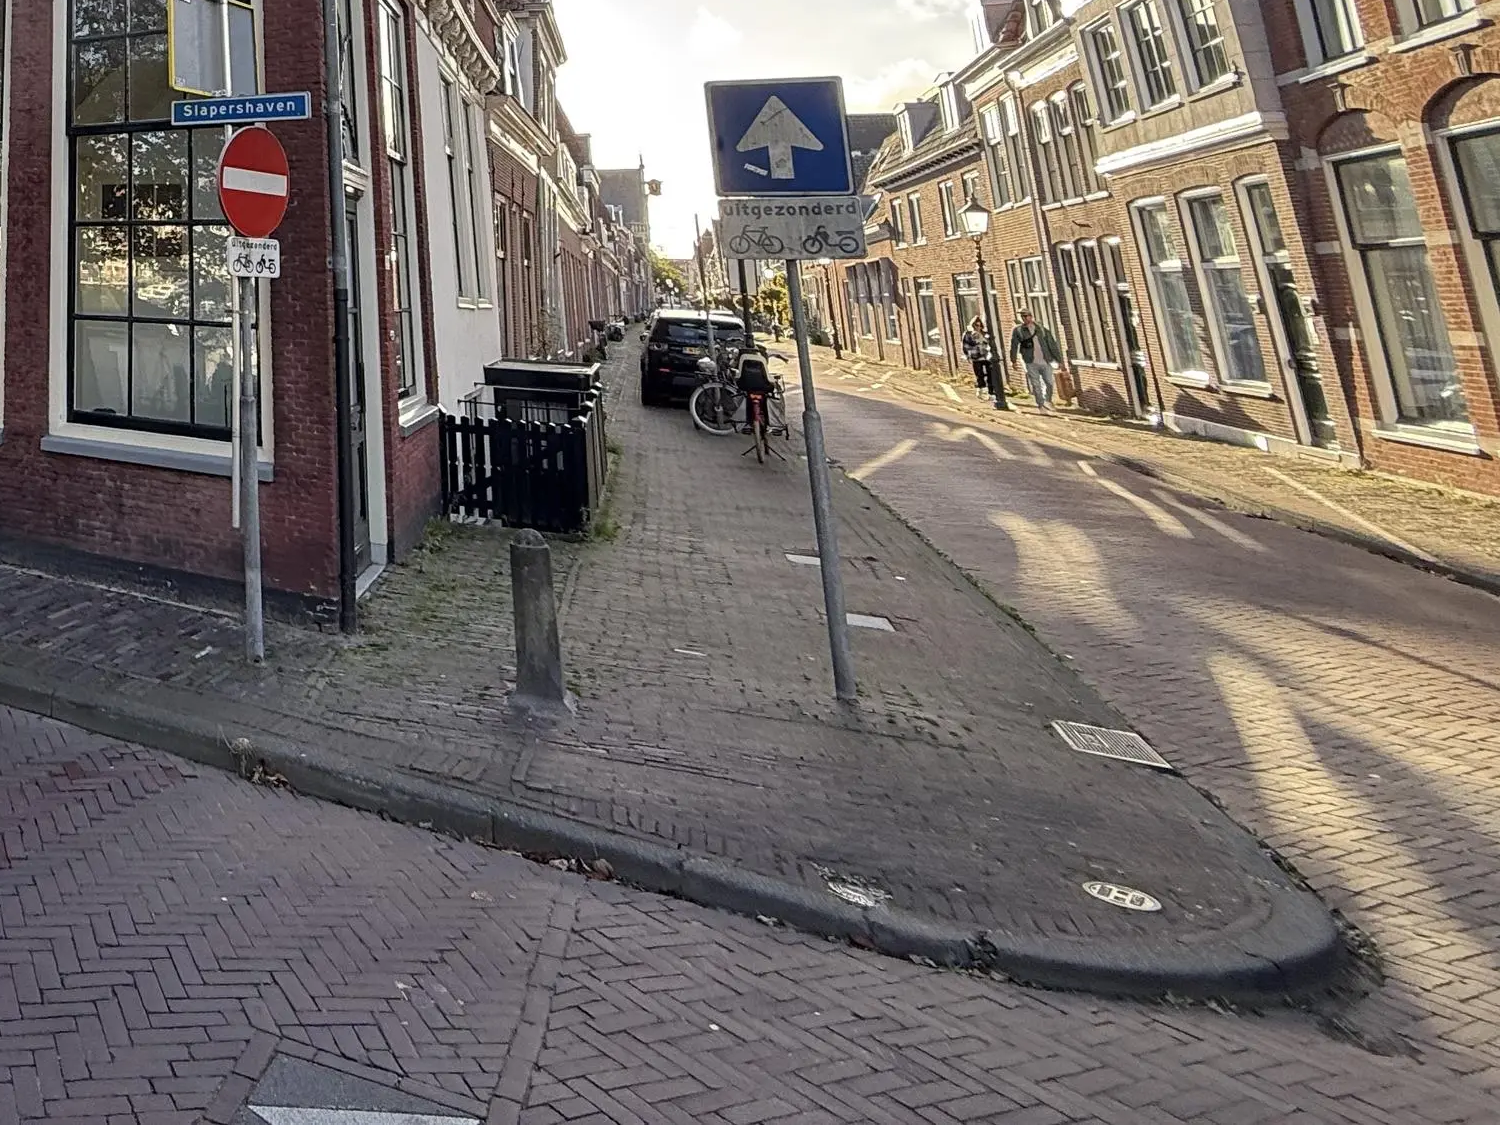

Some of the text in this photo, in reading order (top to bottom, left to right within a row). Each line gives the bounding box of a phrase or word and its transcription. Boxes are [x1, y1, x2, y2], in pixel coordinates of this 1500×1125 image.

[183, 100, 296, 118] Slapershaven
[723, 201, 857, 219] uitgezonderd
[231, 240, 278, 250] uitgezonderd
